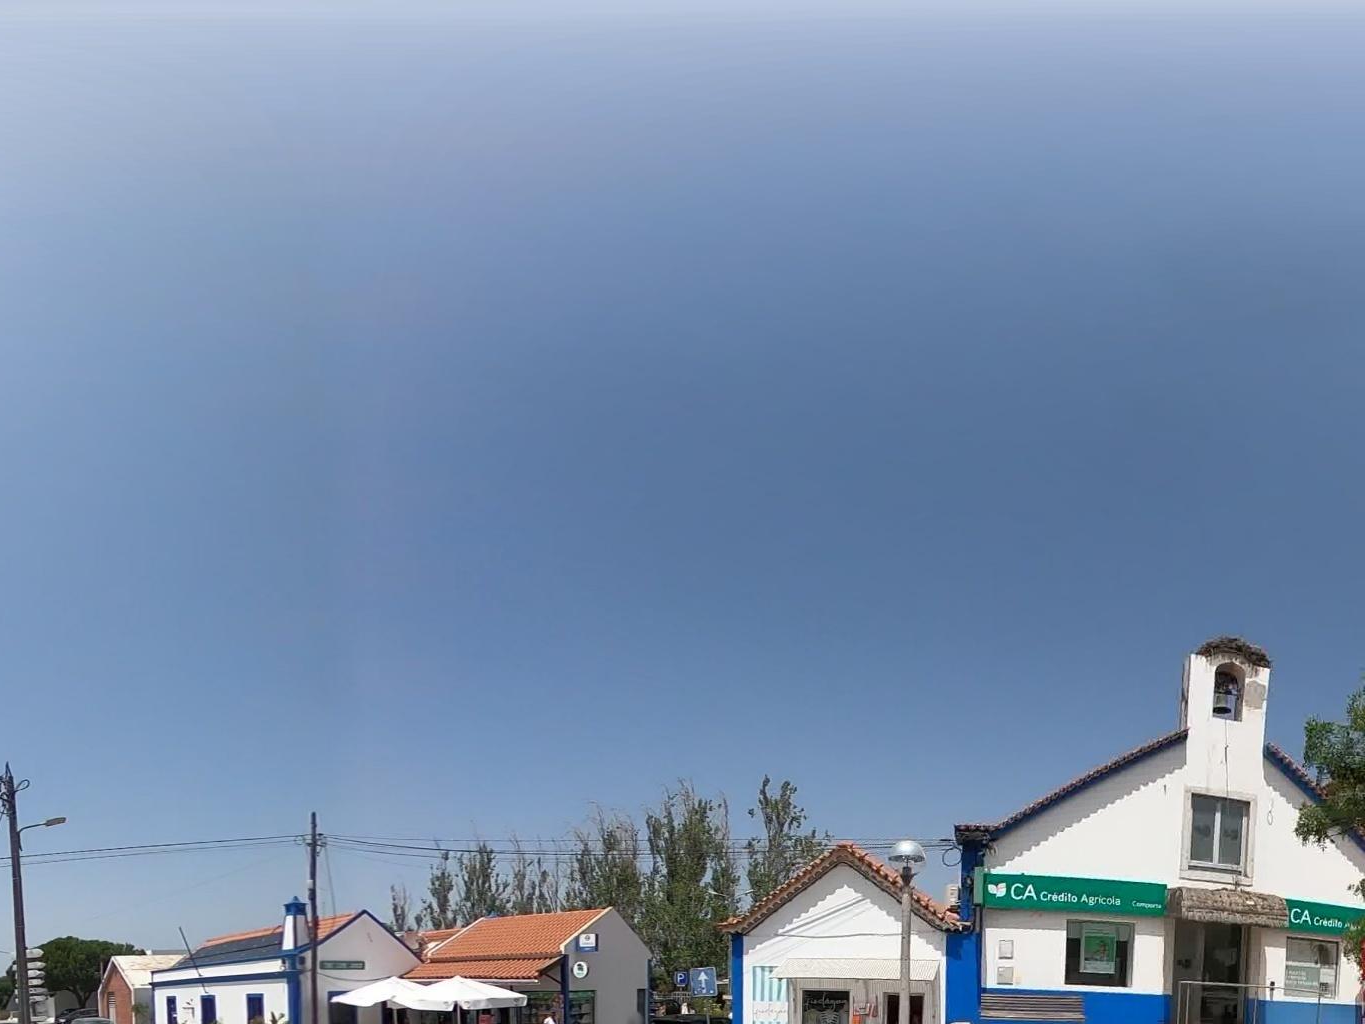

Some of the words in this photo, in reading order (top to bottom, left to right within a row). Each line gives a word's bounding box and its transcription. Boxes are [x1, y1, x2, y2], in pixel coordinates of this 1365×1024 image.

[1010, 883, 1037, 901] CA
[1040, 891, 1078, 903] Crédito
[1290, 908, 1312, 925] CA
[1313, 917, 1343, 928] Crédito
